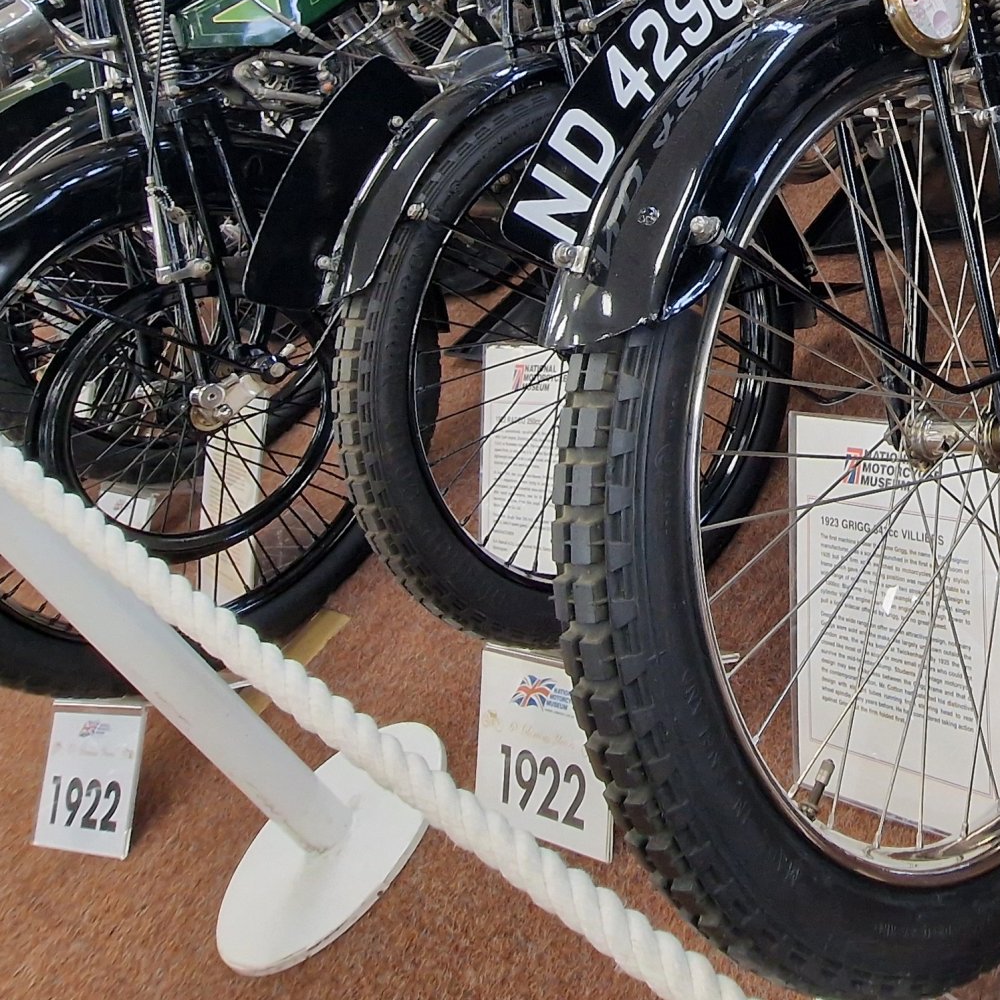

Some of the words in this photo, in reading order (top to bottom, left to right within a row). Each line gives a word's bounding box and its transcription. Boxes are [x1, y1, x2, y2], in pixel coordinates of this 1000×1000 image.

[513, 108, 616, 243] ND
[820, 515, 839, 528] 1923
[841, 518, 871, 534] GRIGG
[49, 775, 122, 833] 1922
[500, 743, 586, 831] 1922
